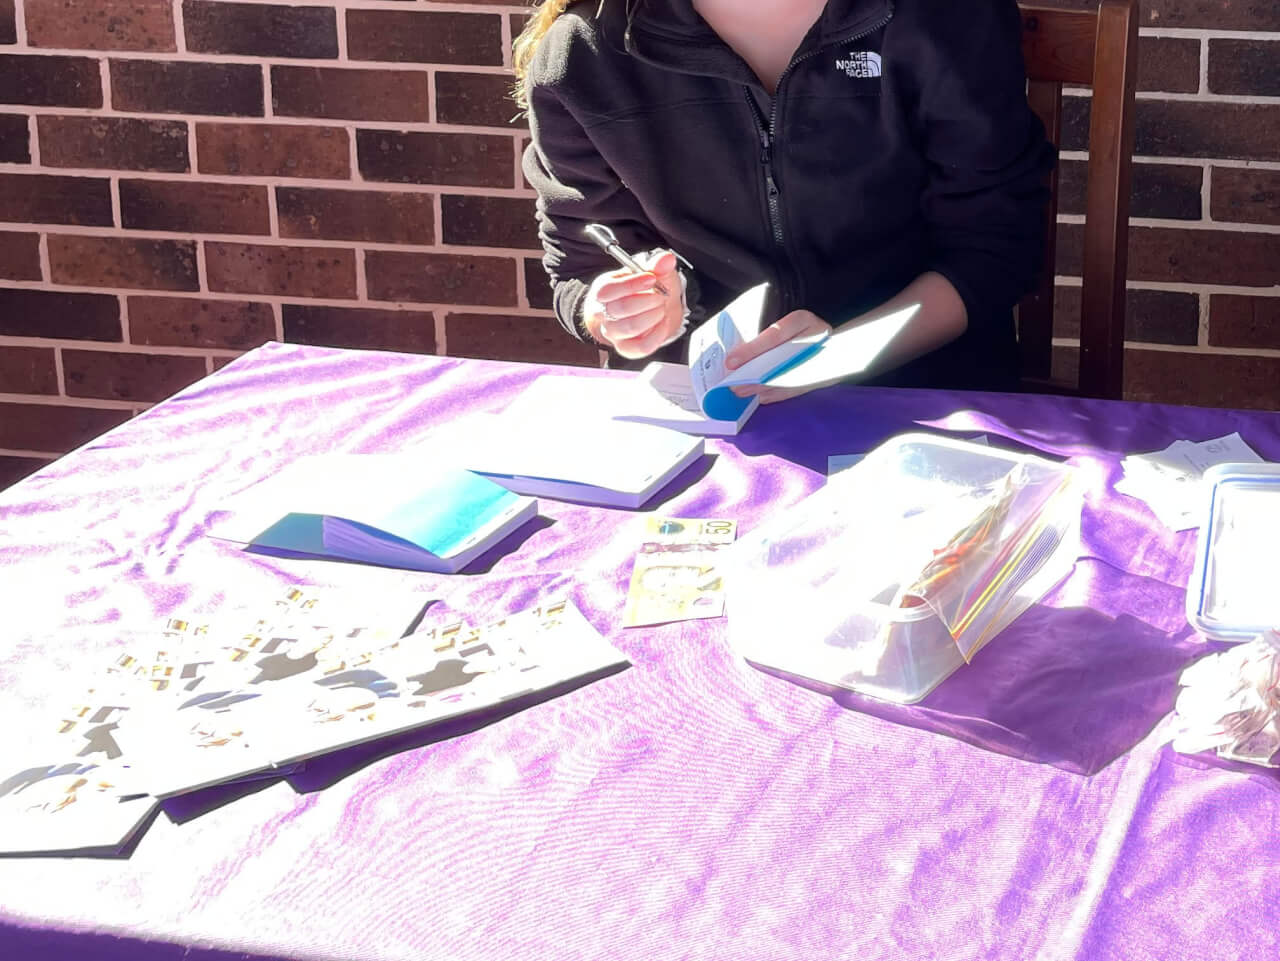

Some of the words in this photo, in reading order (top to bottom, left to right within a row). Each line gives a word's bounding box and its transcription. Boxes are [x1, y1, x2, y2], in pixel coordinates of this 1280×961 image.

[850, 52, 868, 60] THE
[836, 60, 868, 70] NORTH
[846, 69, 870, 78] FACE
[706, 520, 732, 535] 50
